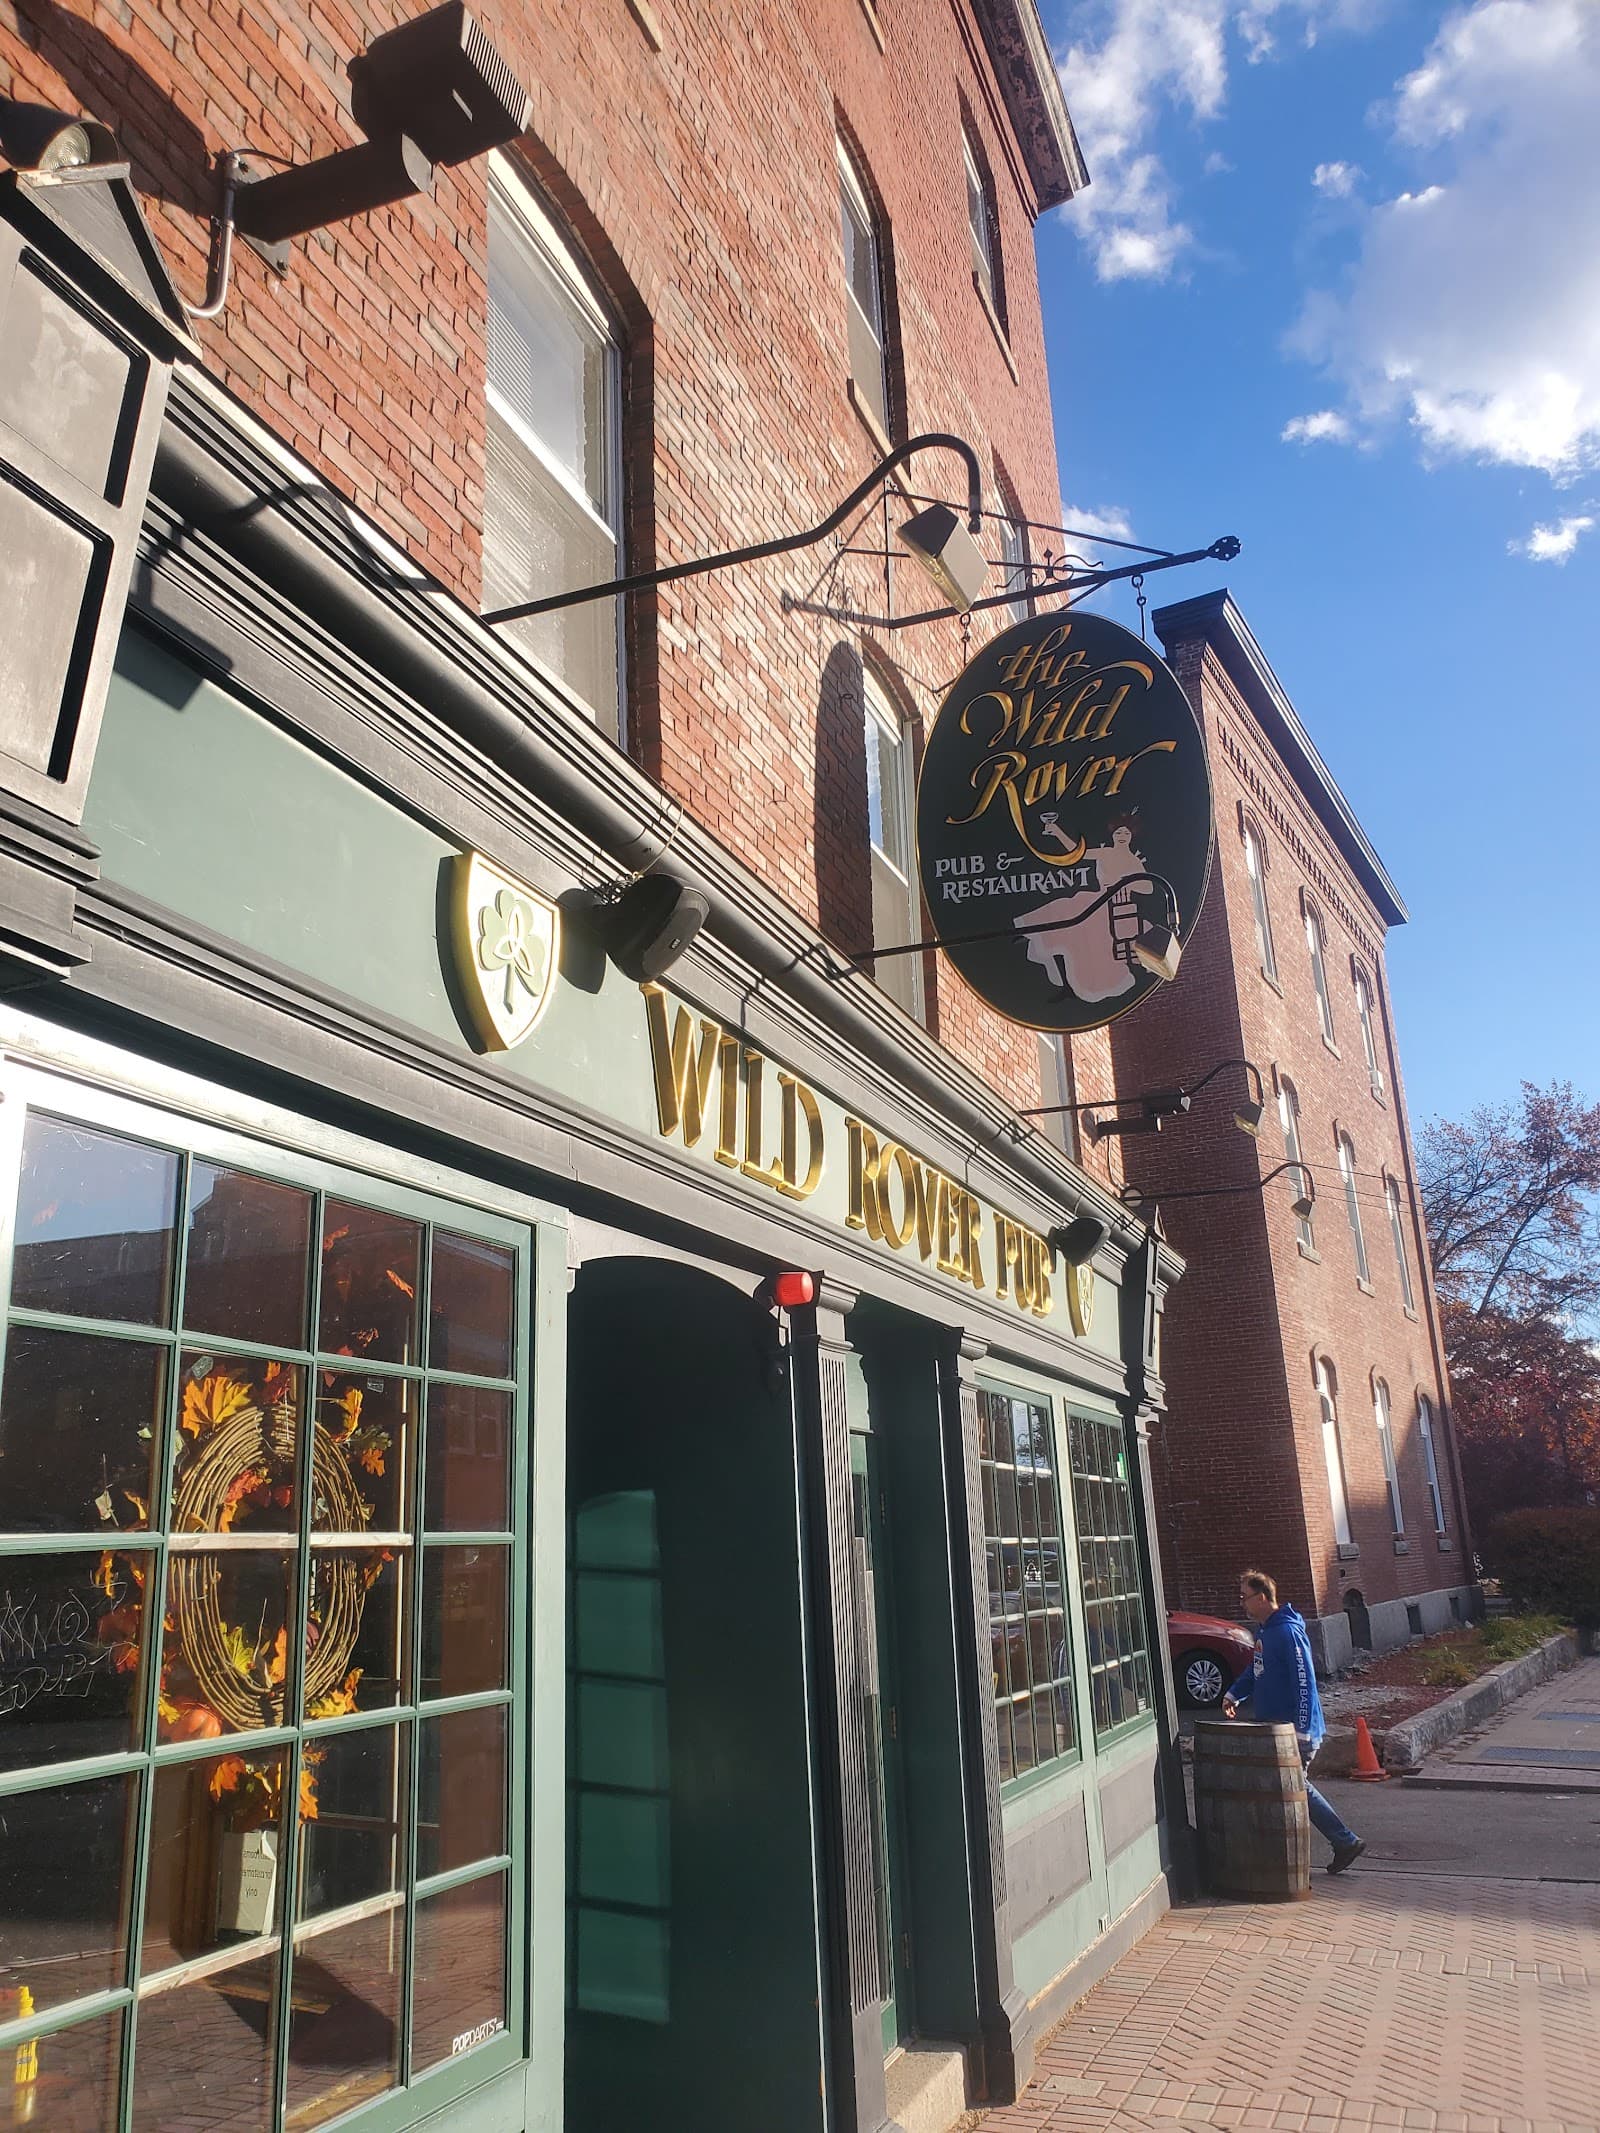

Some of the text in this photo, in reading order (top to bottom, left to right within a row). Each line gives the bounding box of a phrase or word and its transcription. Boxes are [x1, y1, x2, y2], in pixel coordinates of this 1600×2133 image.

[998, 623, 1092, 691] the
[959, 660, 1154, 748] Wild
[945, 740, 1177, 867] Rover
[935, 852, 1025, 878] PUB &
[942, 866, 1092, 904] RESTAURANT
[639, 980, 1054, 1320] WILD ROVER PUB
